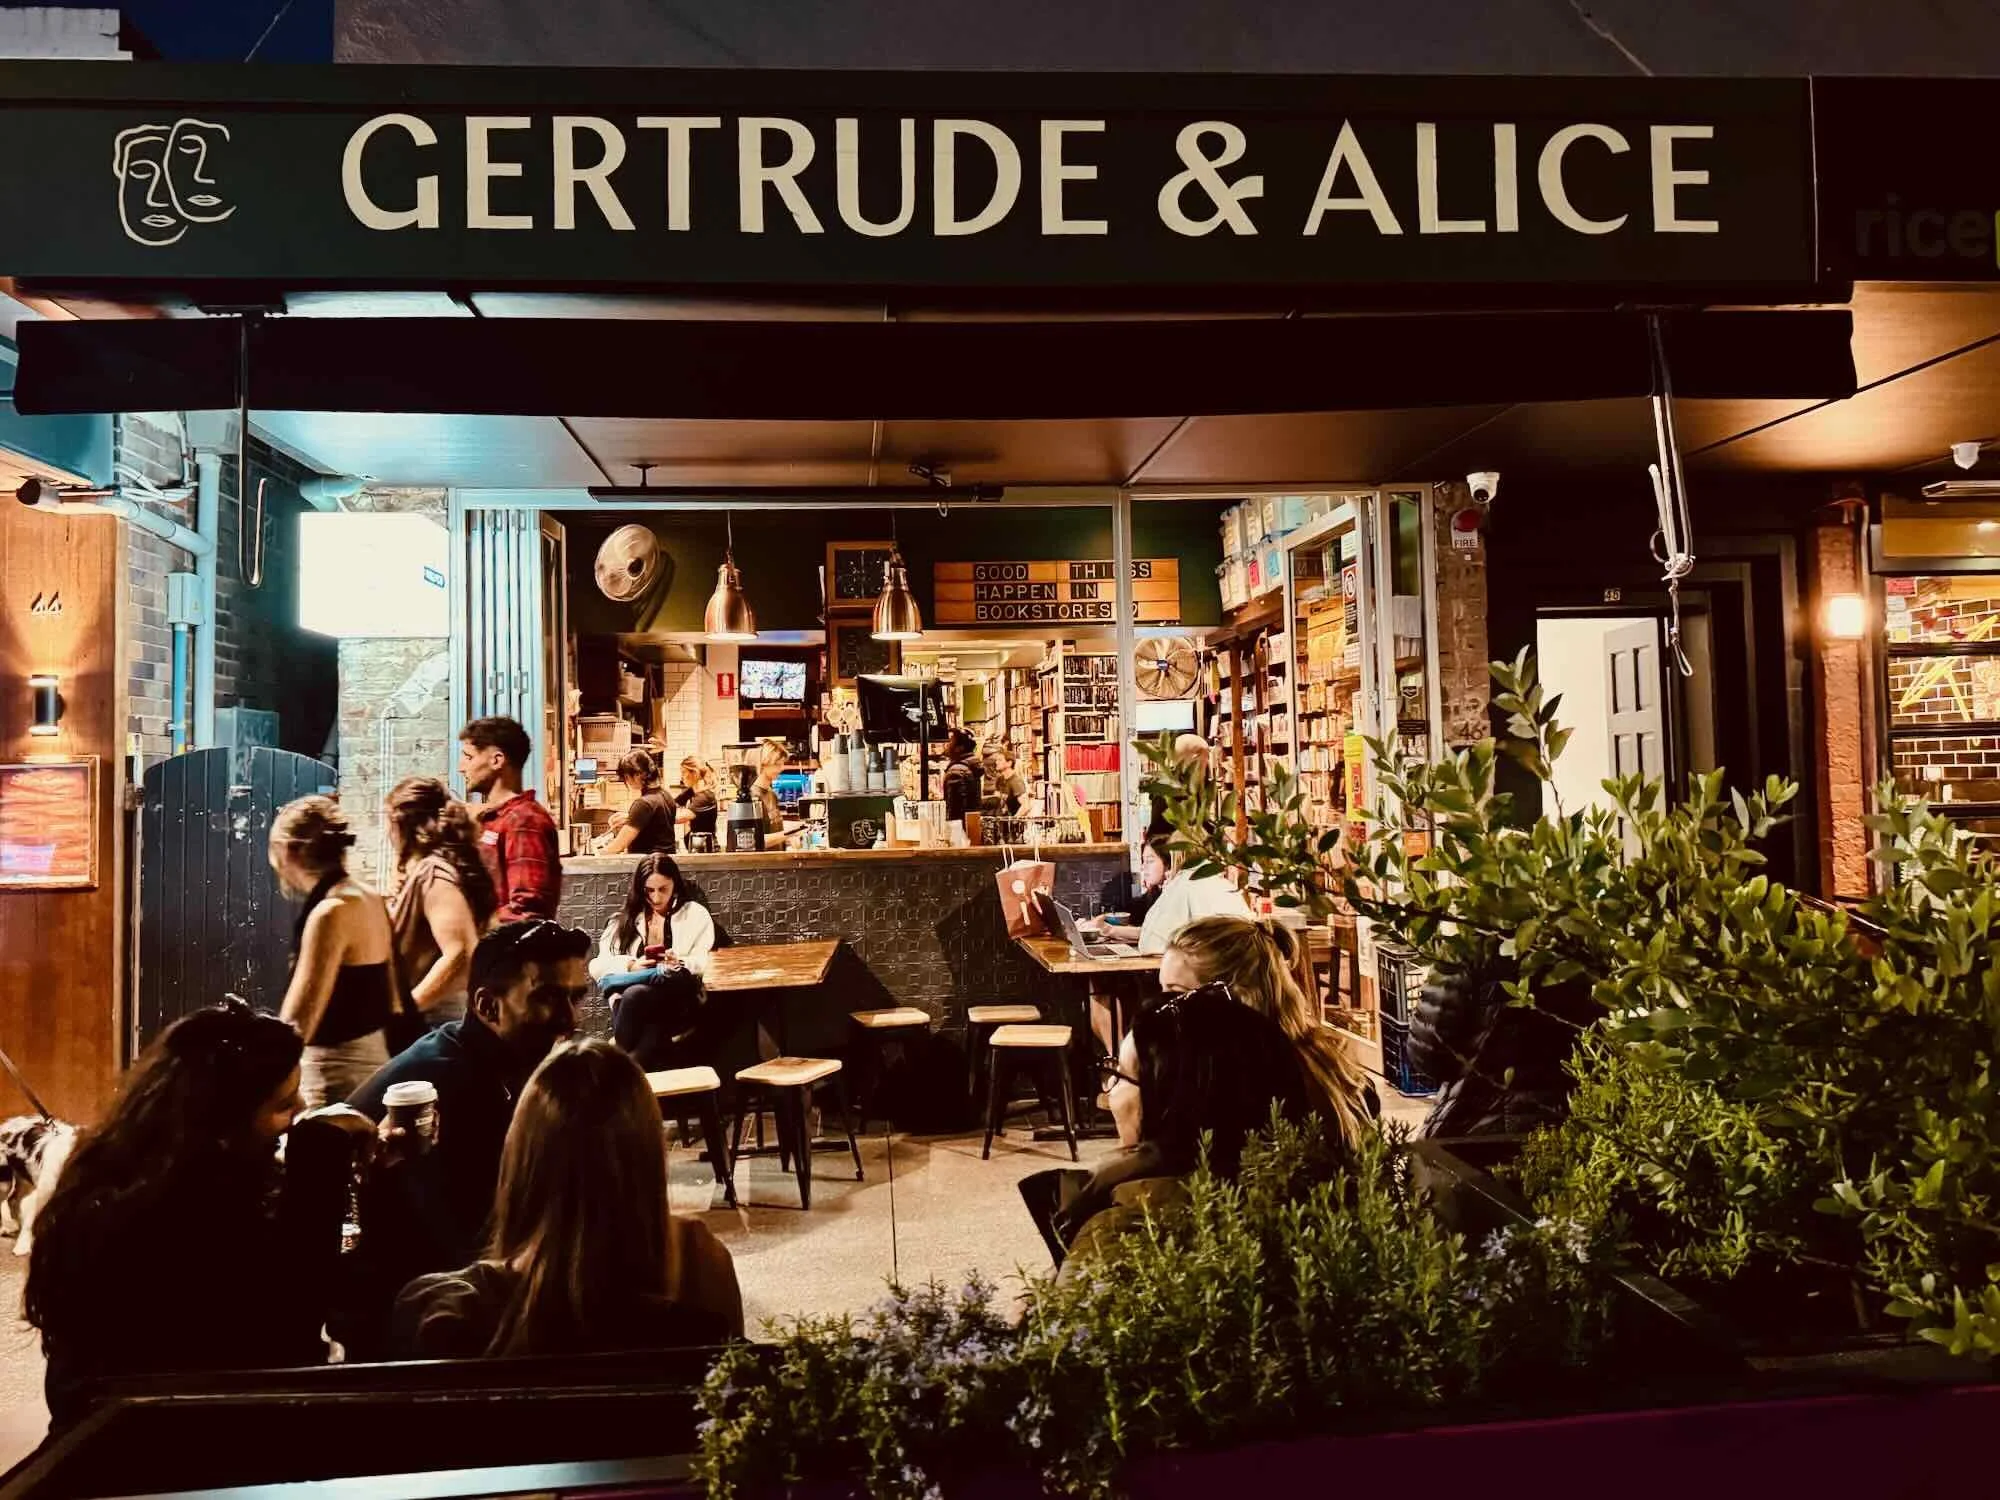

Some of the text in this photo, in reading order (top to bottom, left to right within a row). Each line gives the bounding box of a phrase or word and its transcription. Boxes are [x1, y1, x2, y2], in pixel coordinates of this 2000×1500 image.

[342, 114, 1719, 237] GERTRUDE & ALICE
[1855, 192, 1990, 258] rice
[1454, 539, 1477, 547] FIRE
[976, 562, 1151, 580] GOOD THIGS
[976, 583, 1098, 600] HAPPEN IN
[976, 603, 1112, 619] BOOKSTORES
[1459, 721, 1483, 740] 46
